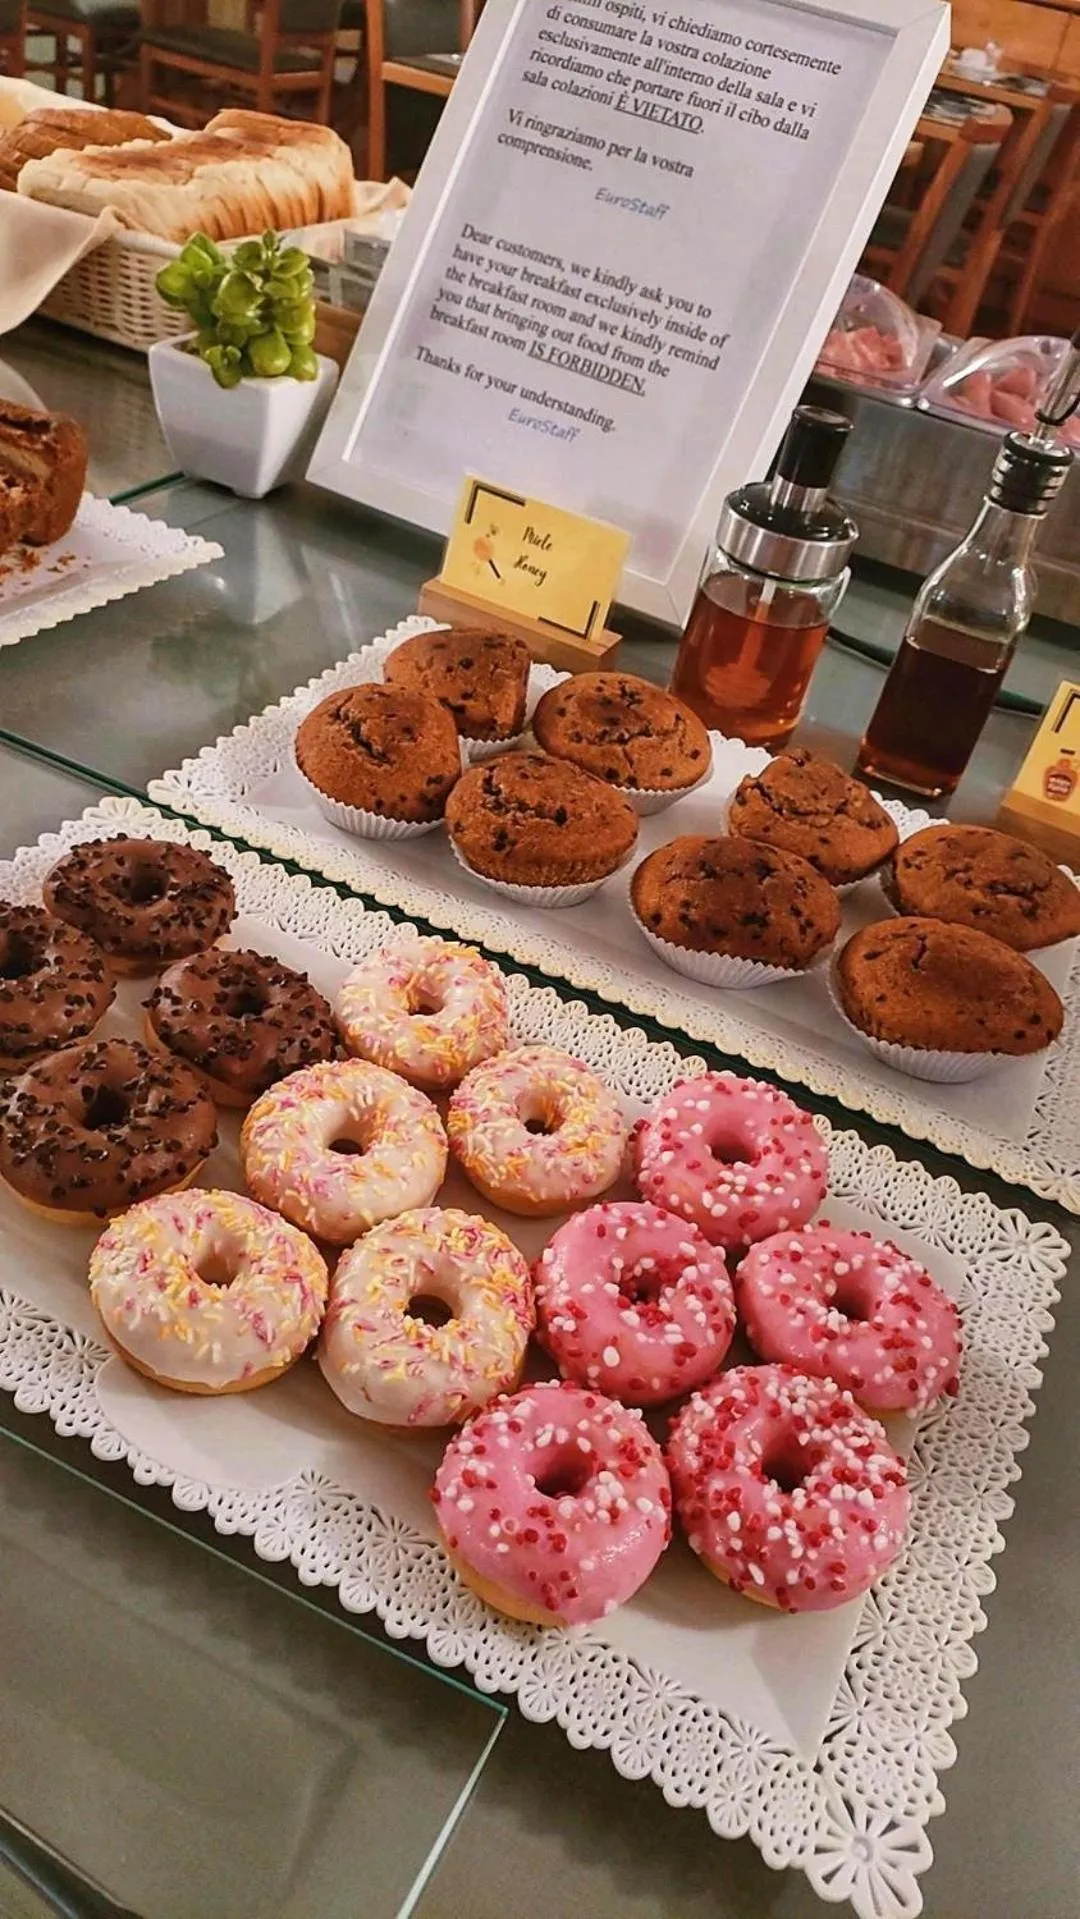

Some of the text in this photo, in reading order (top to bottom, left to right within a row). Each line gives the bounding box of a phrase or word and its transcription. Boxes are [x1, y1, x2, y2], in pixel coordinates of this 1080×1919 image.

[538, 27, 818, 118] esclusivamente all'interno della sala e vi
[547, 5, 772, 80] di consumare la vostra colazione
[605, 1, 842, 75] ospiti, vi chiediamo cortesemente
[522, 69, 705, 134] sala colazioni È VIETATO.
[530, 47, 810, 140] ricordiamo che portare fuori il cibo dalla
[498, 132, 593, 171] comprensione.
[509, 108, 694, 178] Vi ringraziamo per la vostra
[594, 186, 670, 221] EuroStaff
[452, 243, 731, 349] have your breakfast exclusively inside of
[460, 223, 712, 319] Dear customers, we kindly ask you to
[430, 304, 490, 338] breakfast
[491, 330, 527, 351] room
[528, 340, 547, 361] IS
[435, 287, 670, 378] you that bringing out food from the
[444, 265, 721, 371] the breakfast room and we kindly remind
[416, 345, 616, 433] Thanks for your understanding.
[507, 407, 581, 443] EuroStaff
[513, 554, 548, 587] Honey
